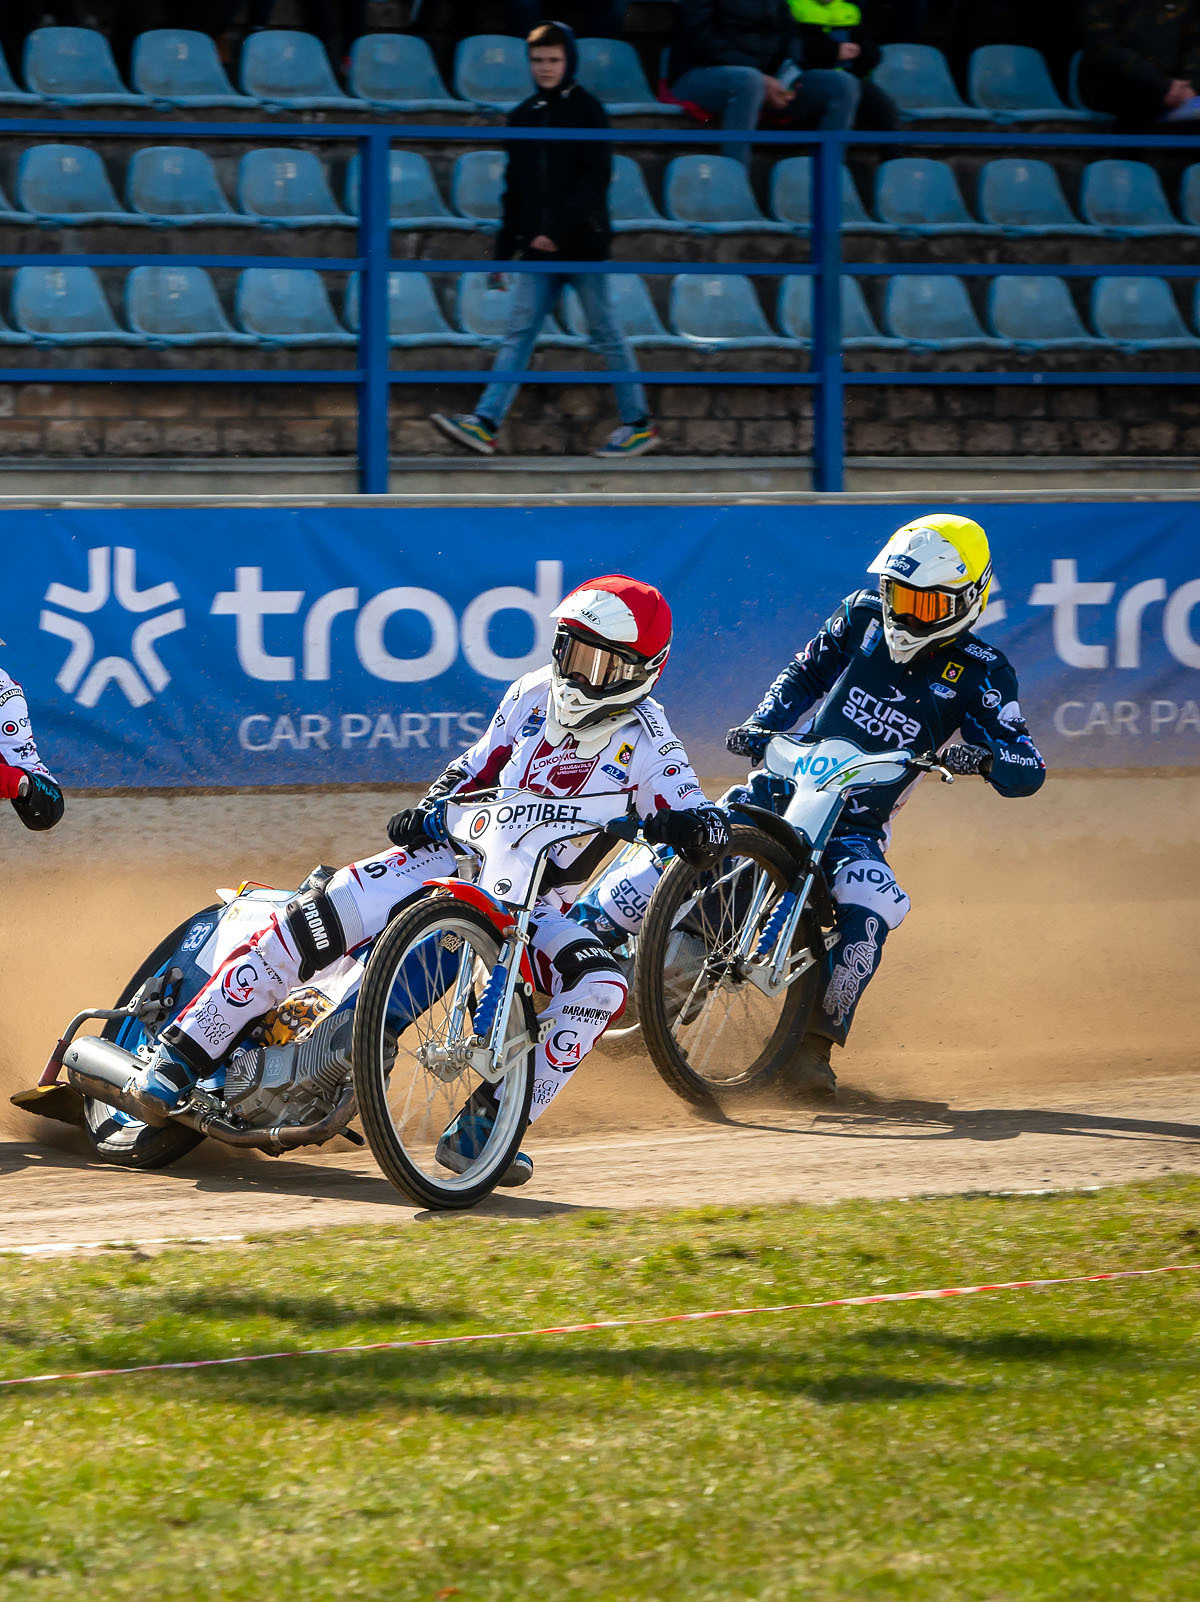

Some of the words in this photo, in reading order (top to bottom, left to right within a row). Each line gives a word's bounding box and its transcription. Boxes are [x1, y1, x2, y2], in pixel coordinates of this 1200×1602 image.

[238, 714, 331, 751] CAR
[341, 711, 486, 750] PARTS
[1053, 700, 1141, 736] CAR
[496, 803, 582, 824] OPTIBET
[205, 996, 234, 1038] YOGGI
[570, 1016, 603, 1026] FAMILY
